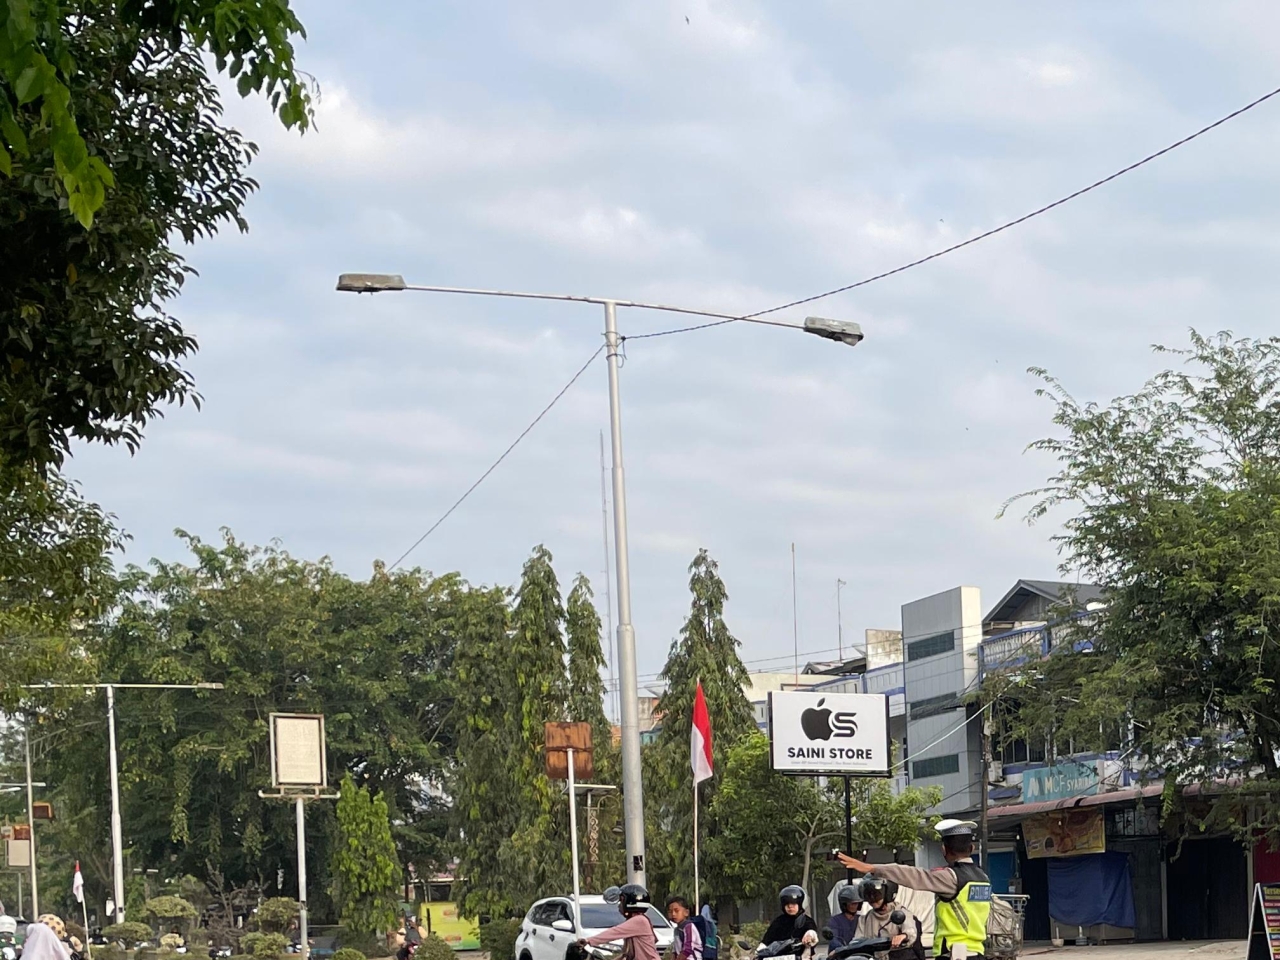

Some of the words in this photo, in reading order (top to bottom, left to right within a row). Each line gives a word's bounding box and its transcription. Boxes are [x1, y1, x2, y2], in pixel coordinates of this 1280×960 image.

[787, 746, 825, 759] SAINI
[829, 747, 873, 760] STORE
[1044, 775, 1065, 794] MCF
